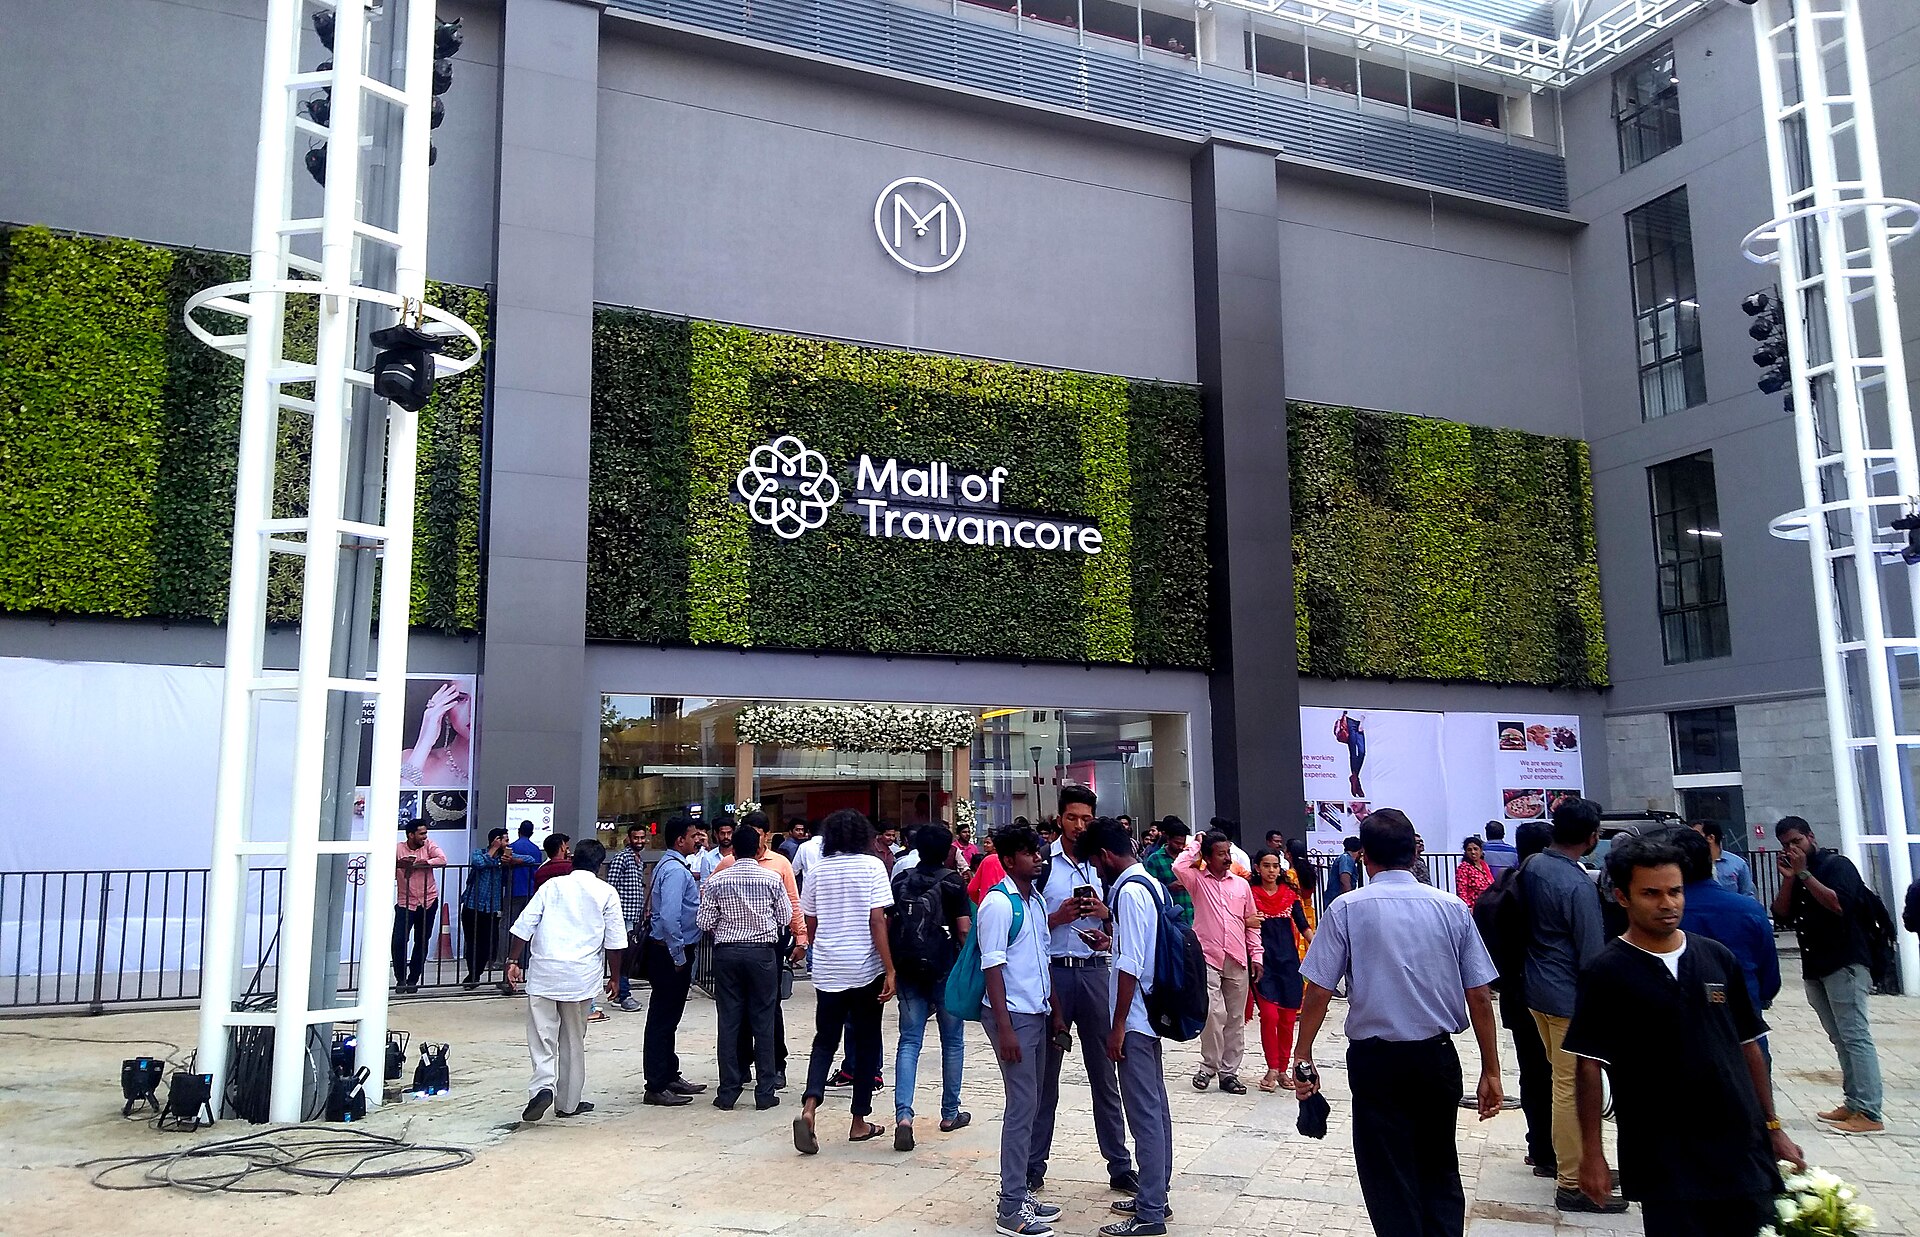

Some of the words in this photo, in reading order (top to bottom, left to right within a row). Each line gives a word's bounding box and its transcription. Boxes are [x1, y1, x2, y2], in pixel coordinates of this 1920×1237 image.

[857, 454, 948, 499] Mall
[961, 466, 1009, 504] of
[857, 498, 1103, 555] Travancore
[1311, 754, 1335, 763] working
